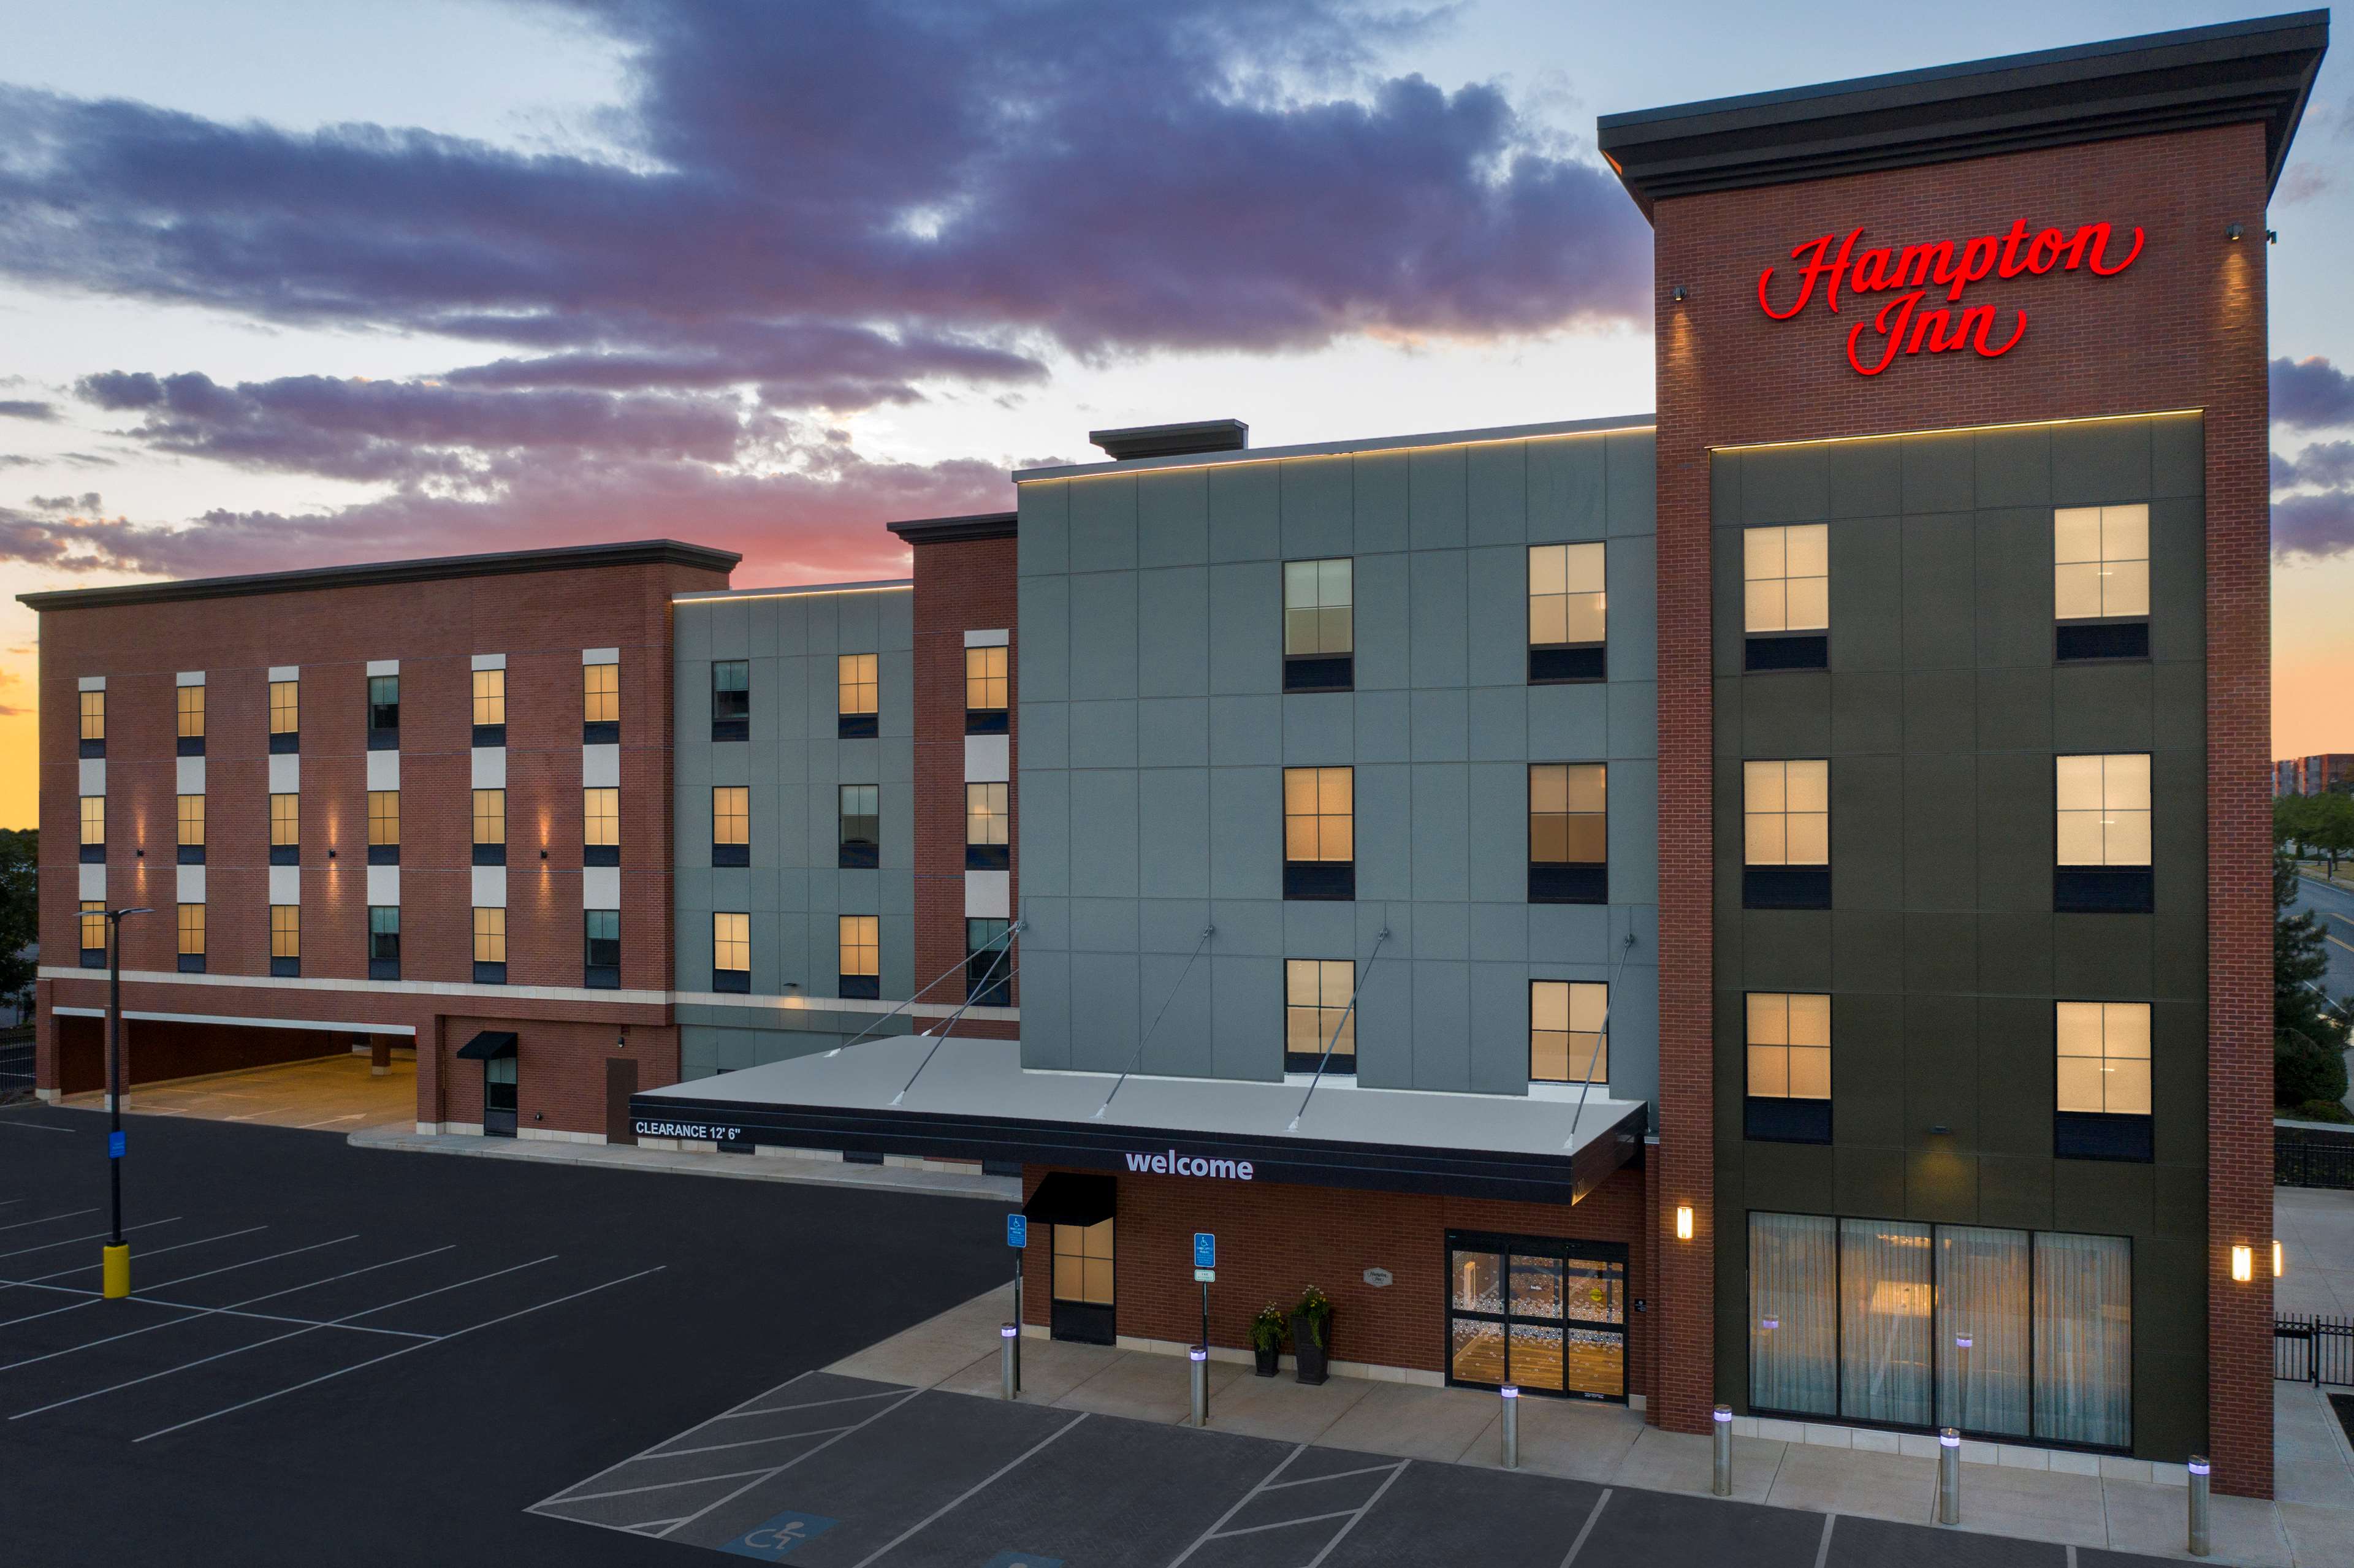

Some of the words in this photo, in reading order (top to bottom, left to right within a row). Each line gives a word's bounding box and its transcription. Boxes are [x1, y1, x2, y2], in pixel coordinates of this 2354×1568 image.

[1758, 218, 2145, 319] Hampton
[1846, 289, 2027, 376] Inn
[636, 1122, 707, 1138] CLEARANCE
[709, 1127, 725, 1139] 12'
[728, 1128, 741, 1140] 6"
[1126, 1149, 1254, 1180] welcome
